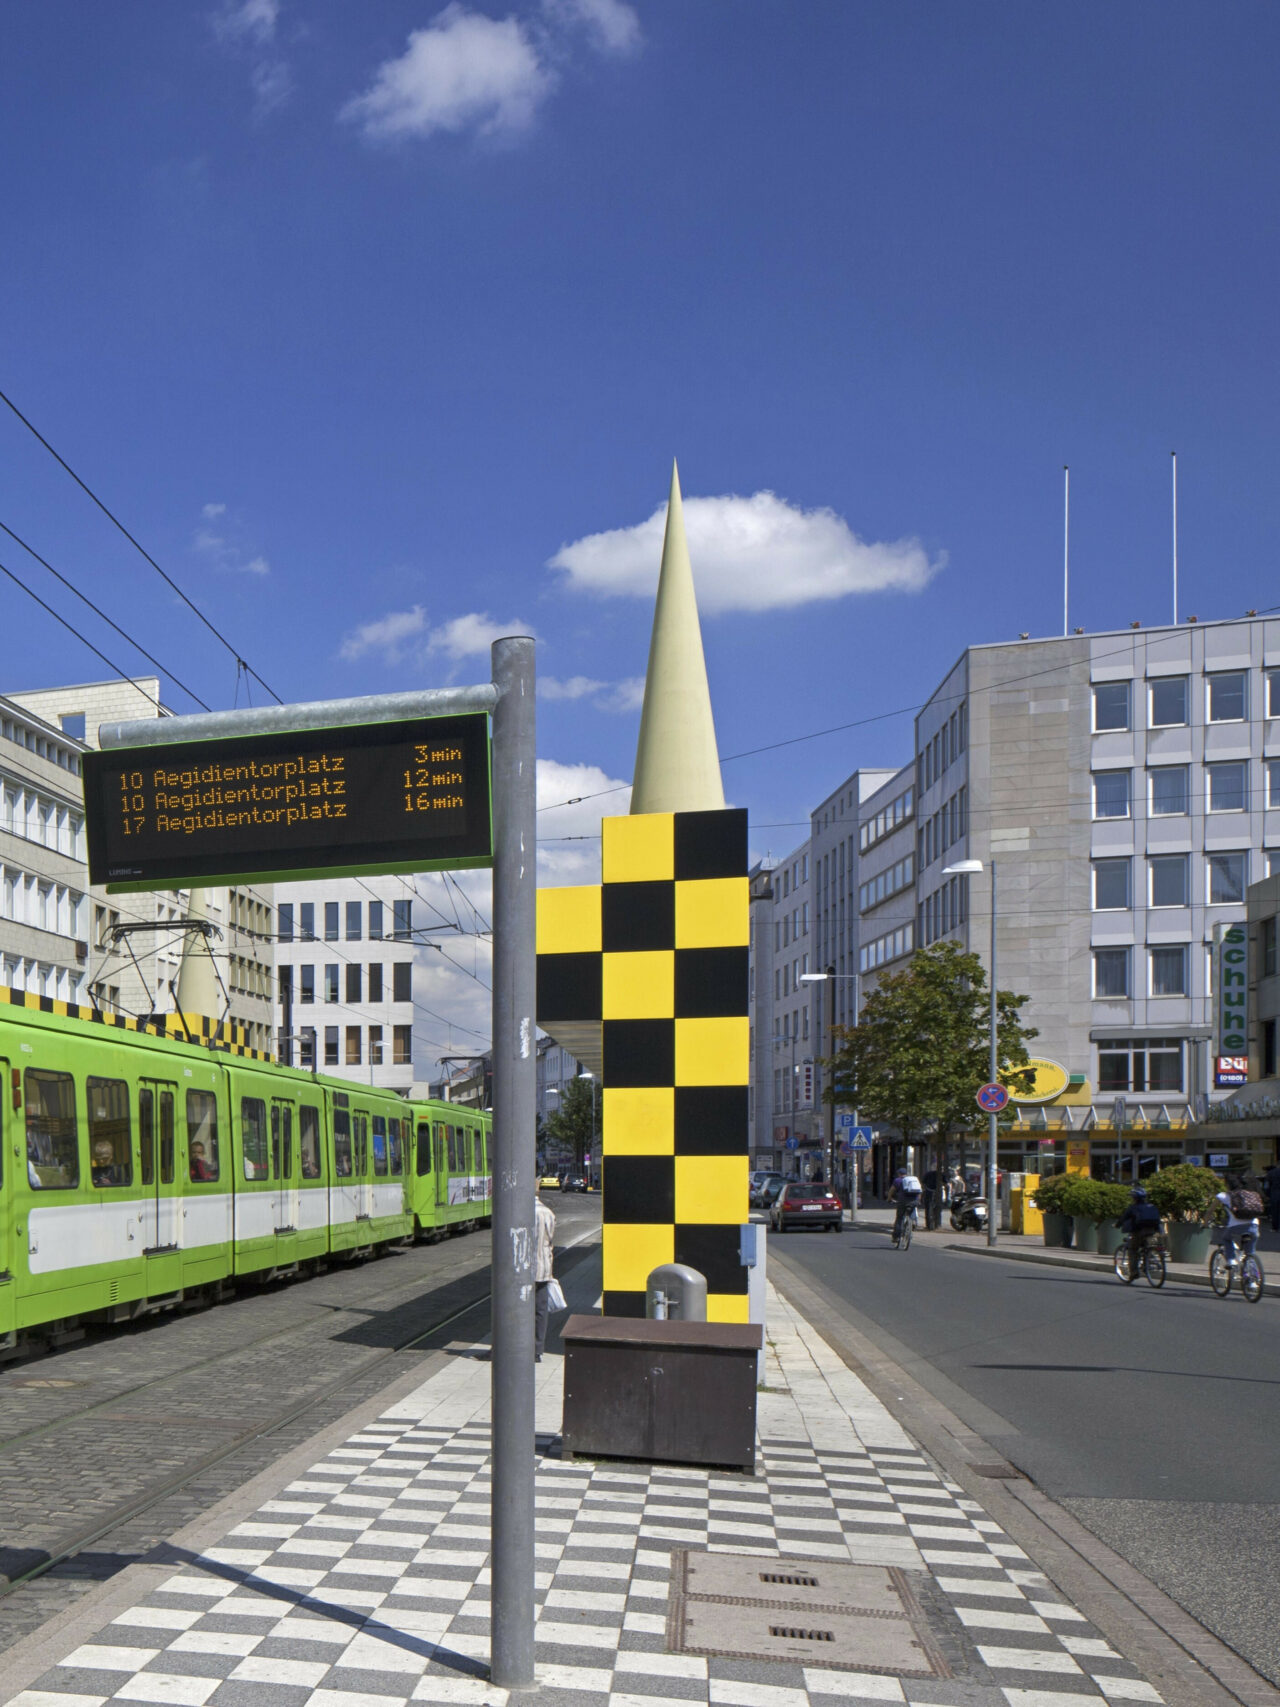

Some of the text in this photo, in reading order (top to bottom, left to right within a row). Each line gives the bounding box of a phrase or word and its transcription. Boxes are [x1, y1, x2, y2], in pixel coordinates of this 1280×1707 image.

[120, 745, 462, 790] 10 Aegidientorplatz 3 min
[122, 769, 463, 813] 10 Aegidientorplatz 12 min
[123, 792, 464, 834] 17 Aegidientorplatz 16 min
[1223, 928, 1245, 1050] schuhe
